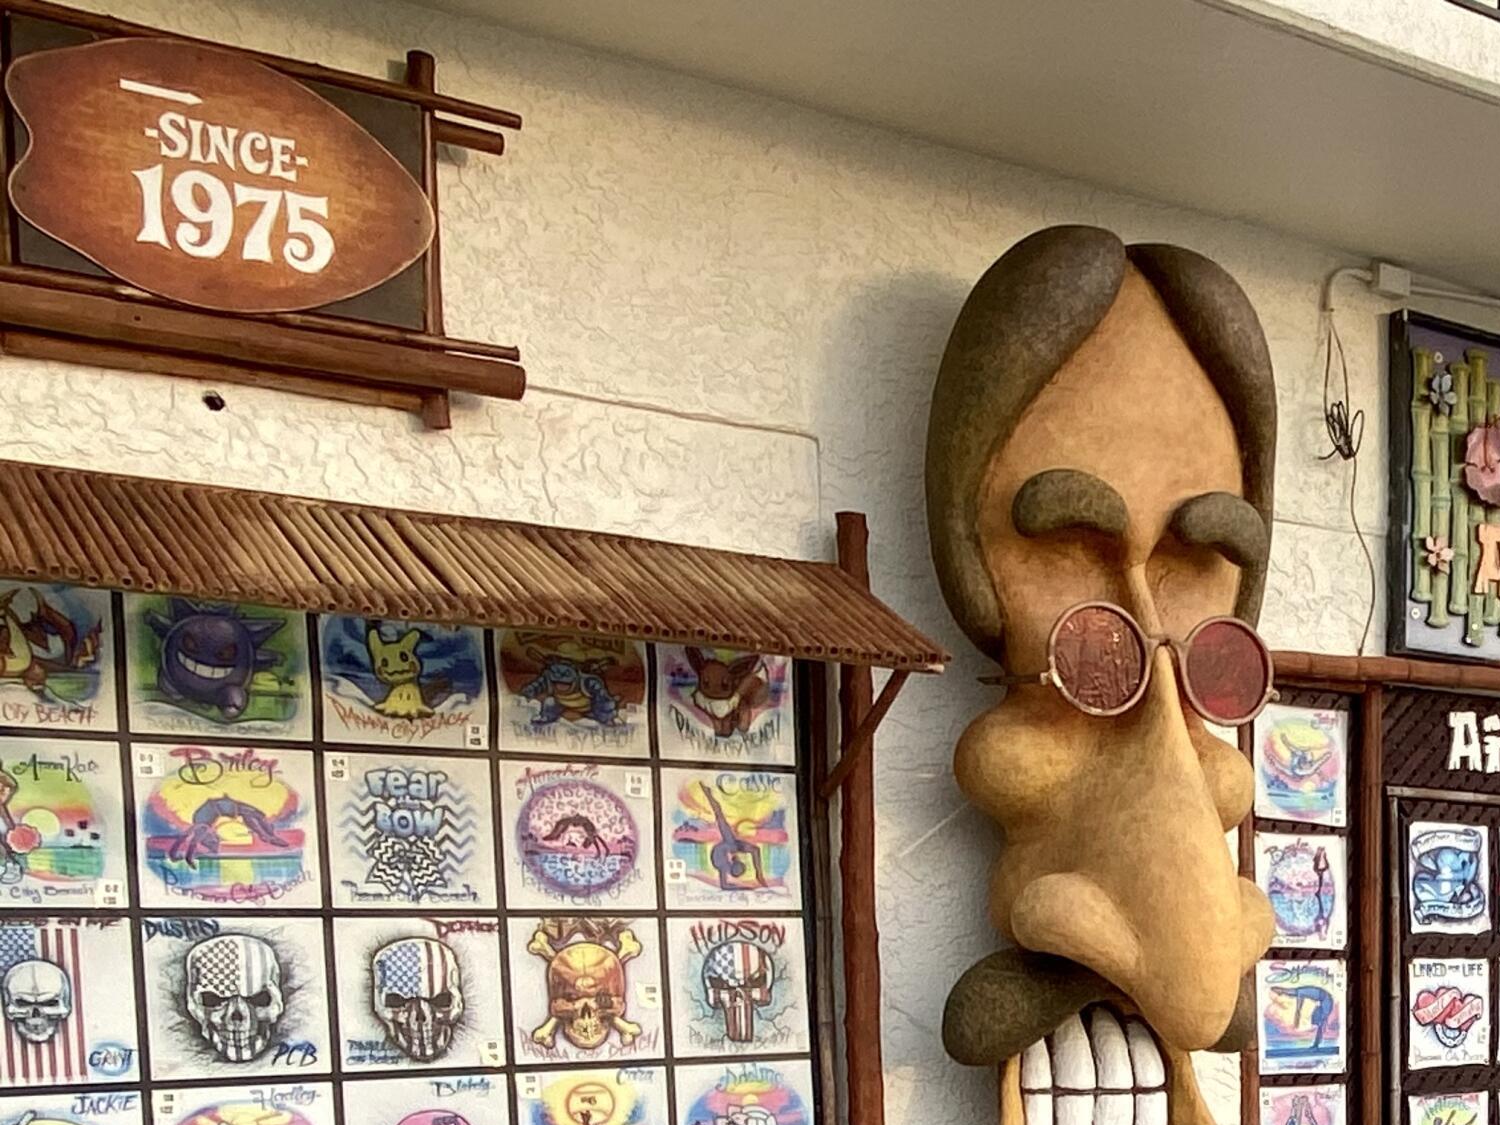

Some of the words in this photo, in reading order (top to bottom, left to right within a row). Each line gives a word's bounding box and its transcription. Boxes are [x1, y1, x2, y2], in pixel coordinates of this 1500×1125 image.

[133, 164, 336, 274] 1975
[689, 920, 786, 949] HUDSON
[272, 1041, 318, 1067] PCB
